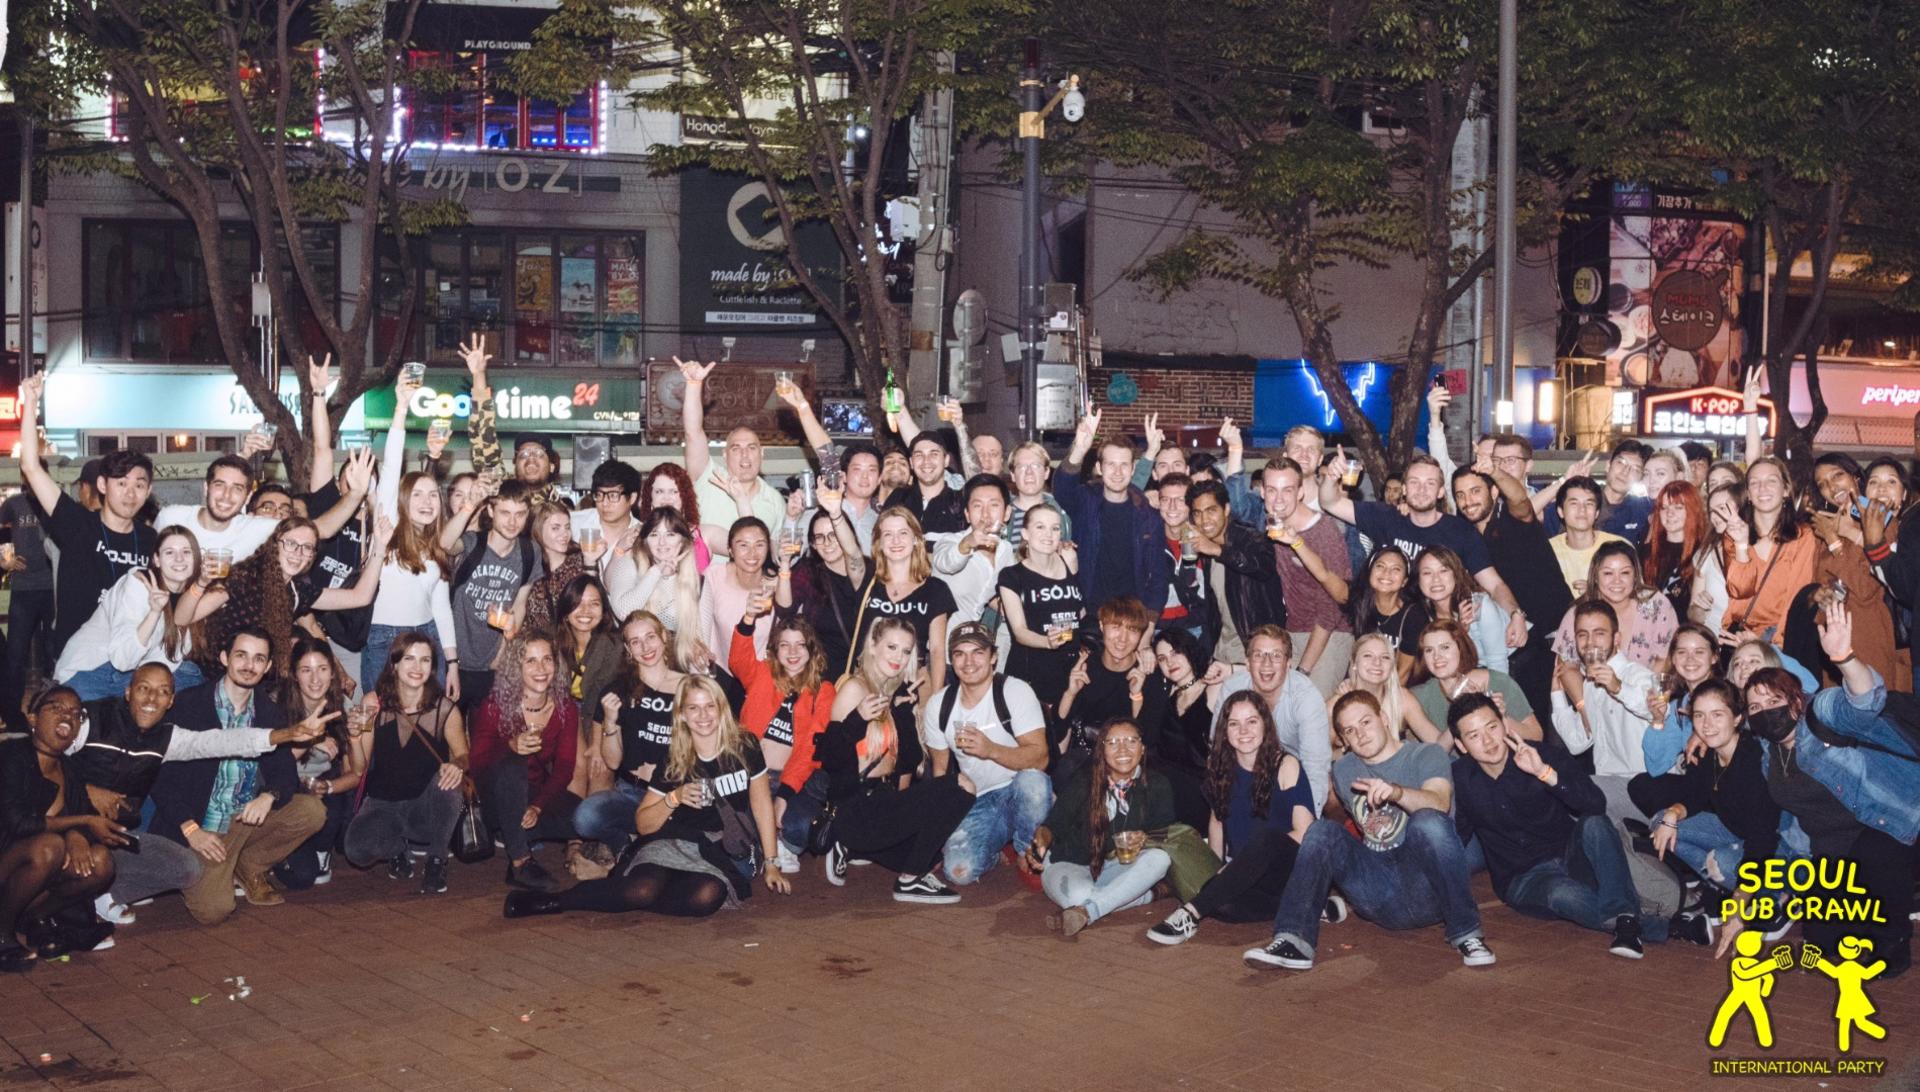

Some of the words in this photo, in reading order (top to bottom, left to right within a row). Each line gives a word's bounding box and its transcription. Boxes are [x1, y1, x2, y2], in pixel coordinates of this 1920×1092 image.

[464, 39, 532, 51] PLAYGROUND
[423, 151, 471, 203] by
[711, 262, 750, 282] made
[752, 262, 772, 291] by
[1660, 307, 1715, 328] 스테이크
[409, 386, 472, 418] Goo
[495, 386, 572, 419] time
[573, 382, 600, 406] 24
[638, 730, 655, 742] PUB
[655, 735, 672, 744] CRA
[647, 722, 672, 734] SEOU
